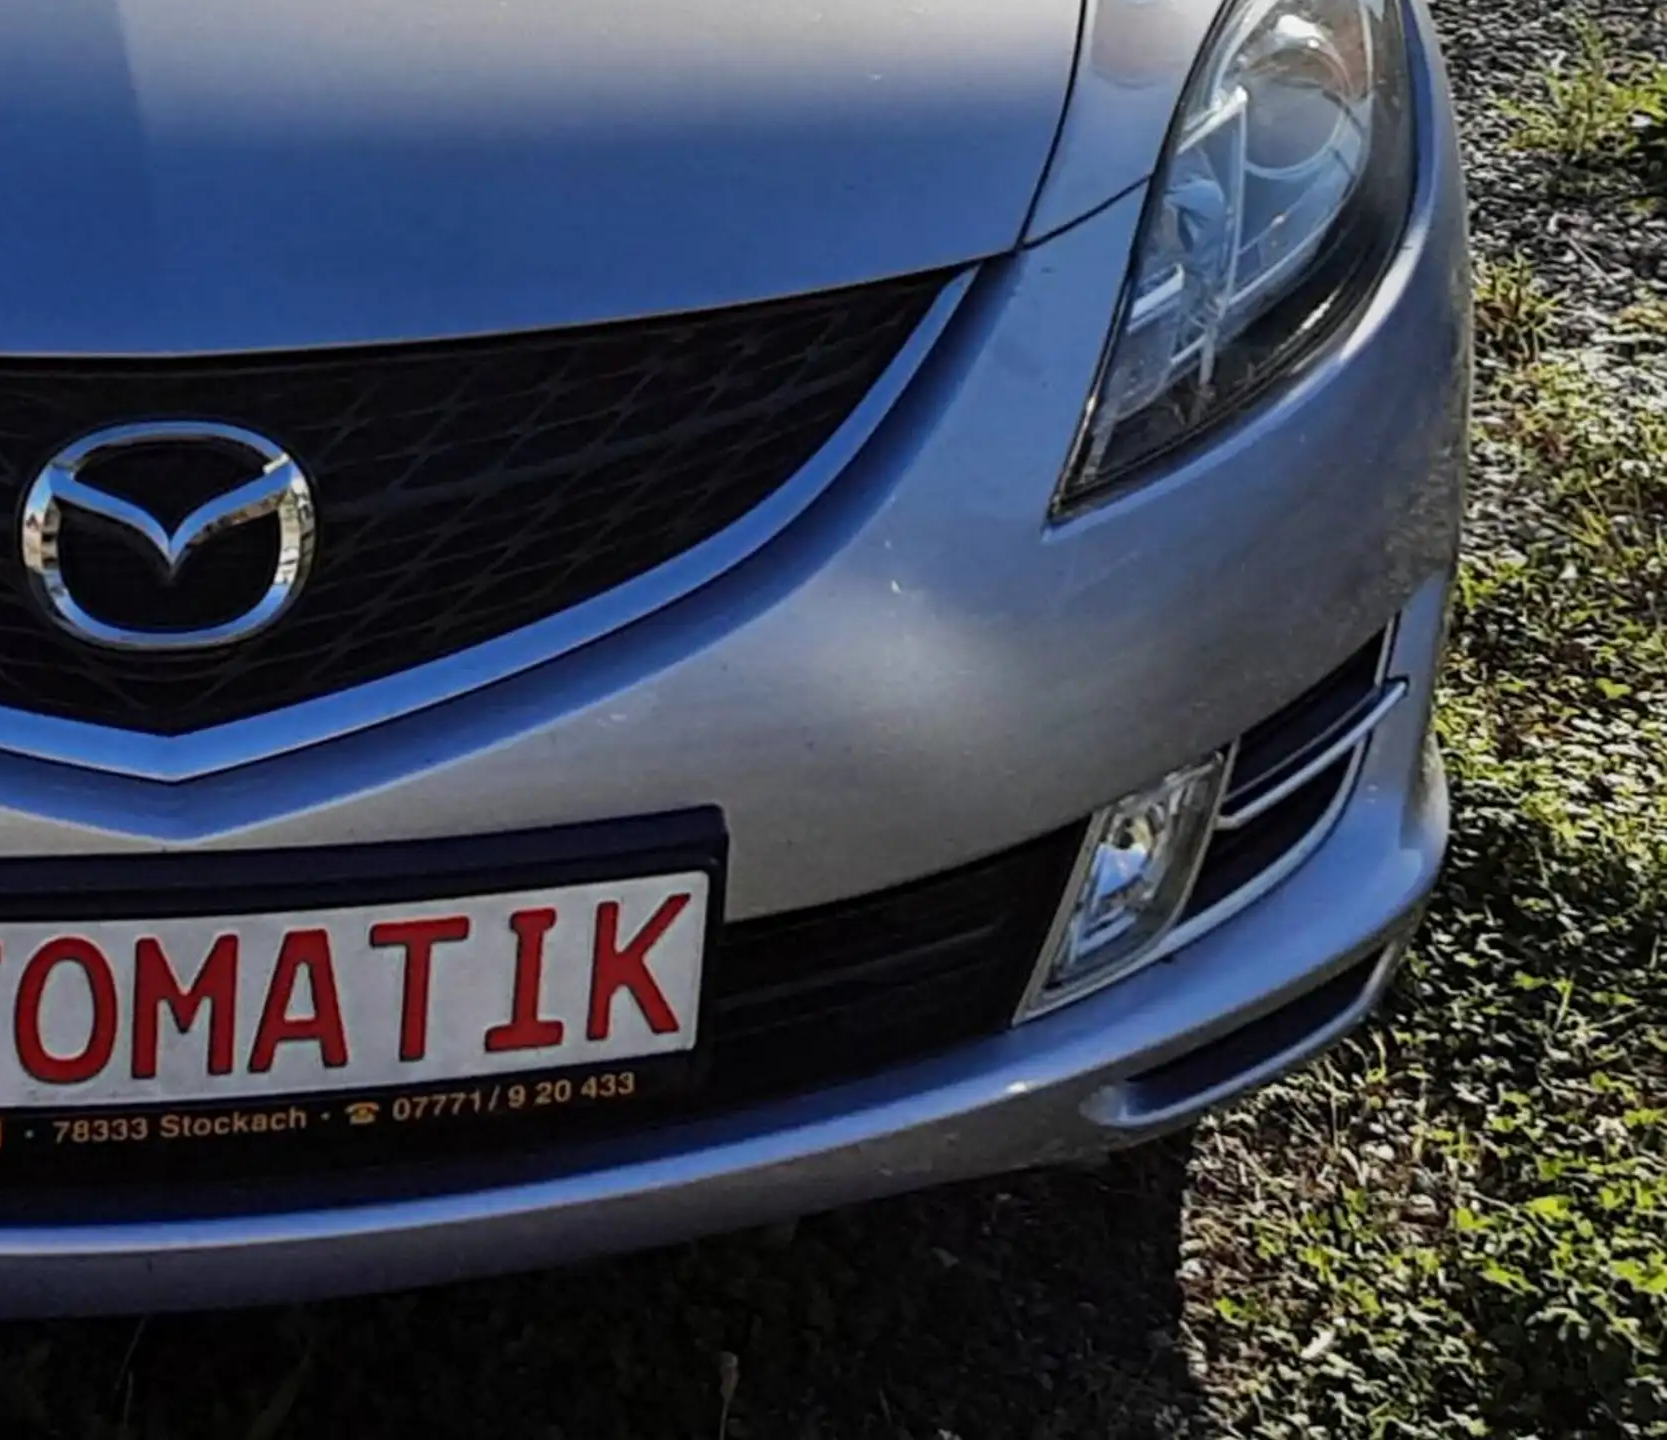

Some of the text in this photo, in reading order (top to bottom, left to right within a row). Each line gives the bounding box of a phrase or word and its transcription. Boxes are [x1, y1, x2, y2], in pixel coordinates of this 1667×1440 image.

[53, 1117, 149, 1143] 78333
[159, 1106, 307, 1139] Stockach
[533, 1078, 573, 1106] 20
[579, 1070, 636, 1100] 433
